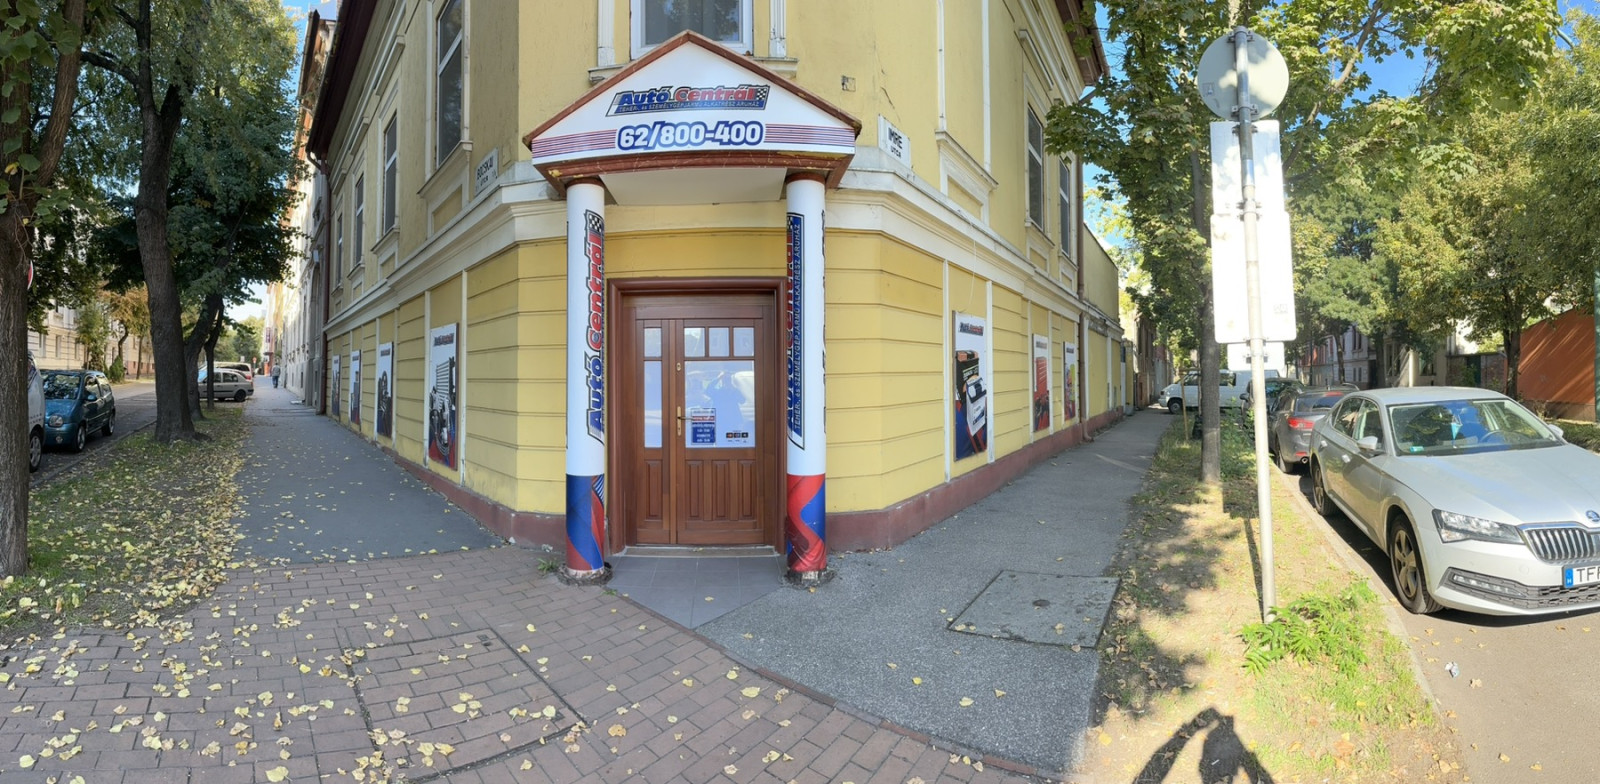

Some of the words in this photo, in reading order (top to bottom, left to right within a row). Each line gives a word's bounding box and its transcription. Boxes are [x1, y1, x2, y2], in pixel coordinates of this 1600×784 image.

[620, 123, 761, 147] 62/800-400
[888, 127, 902, 150] IMRE
[477, 155, 494, 180] BOCSKAI
